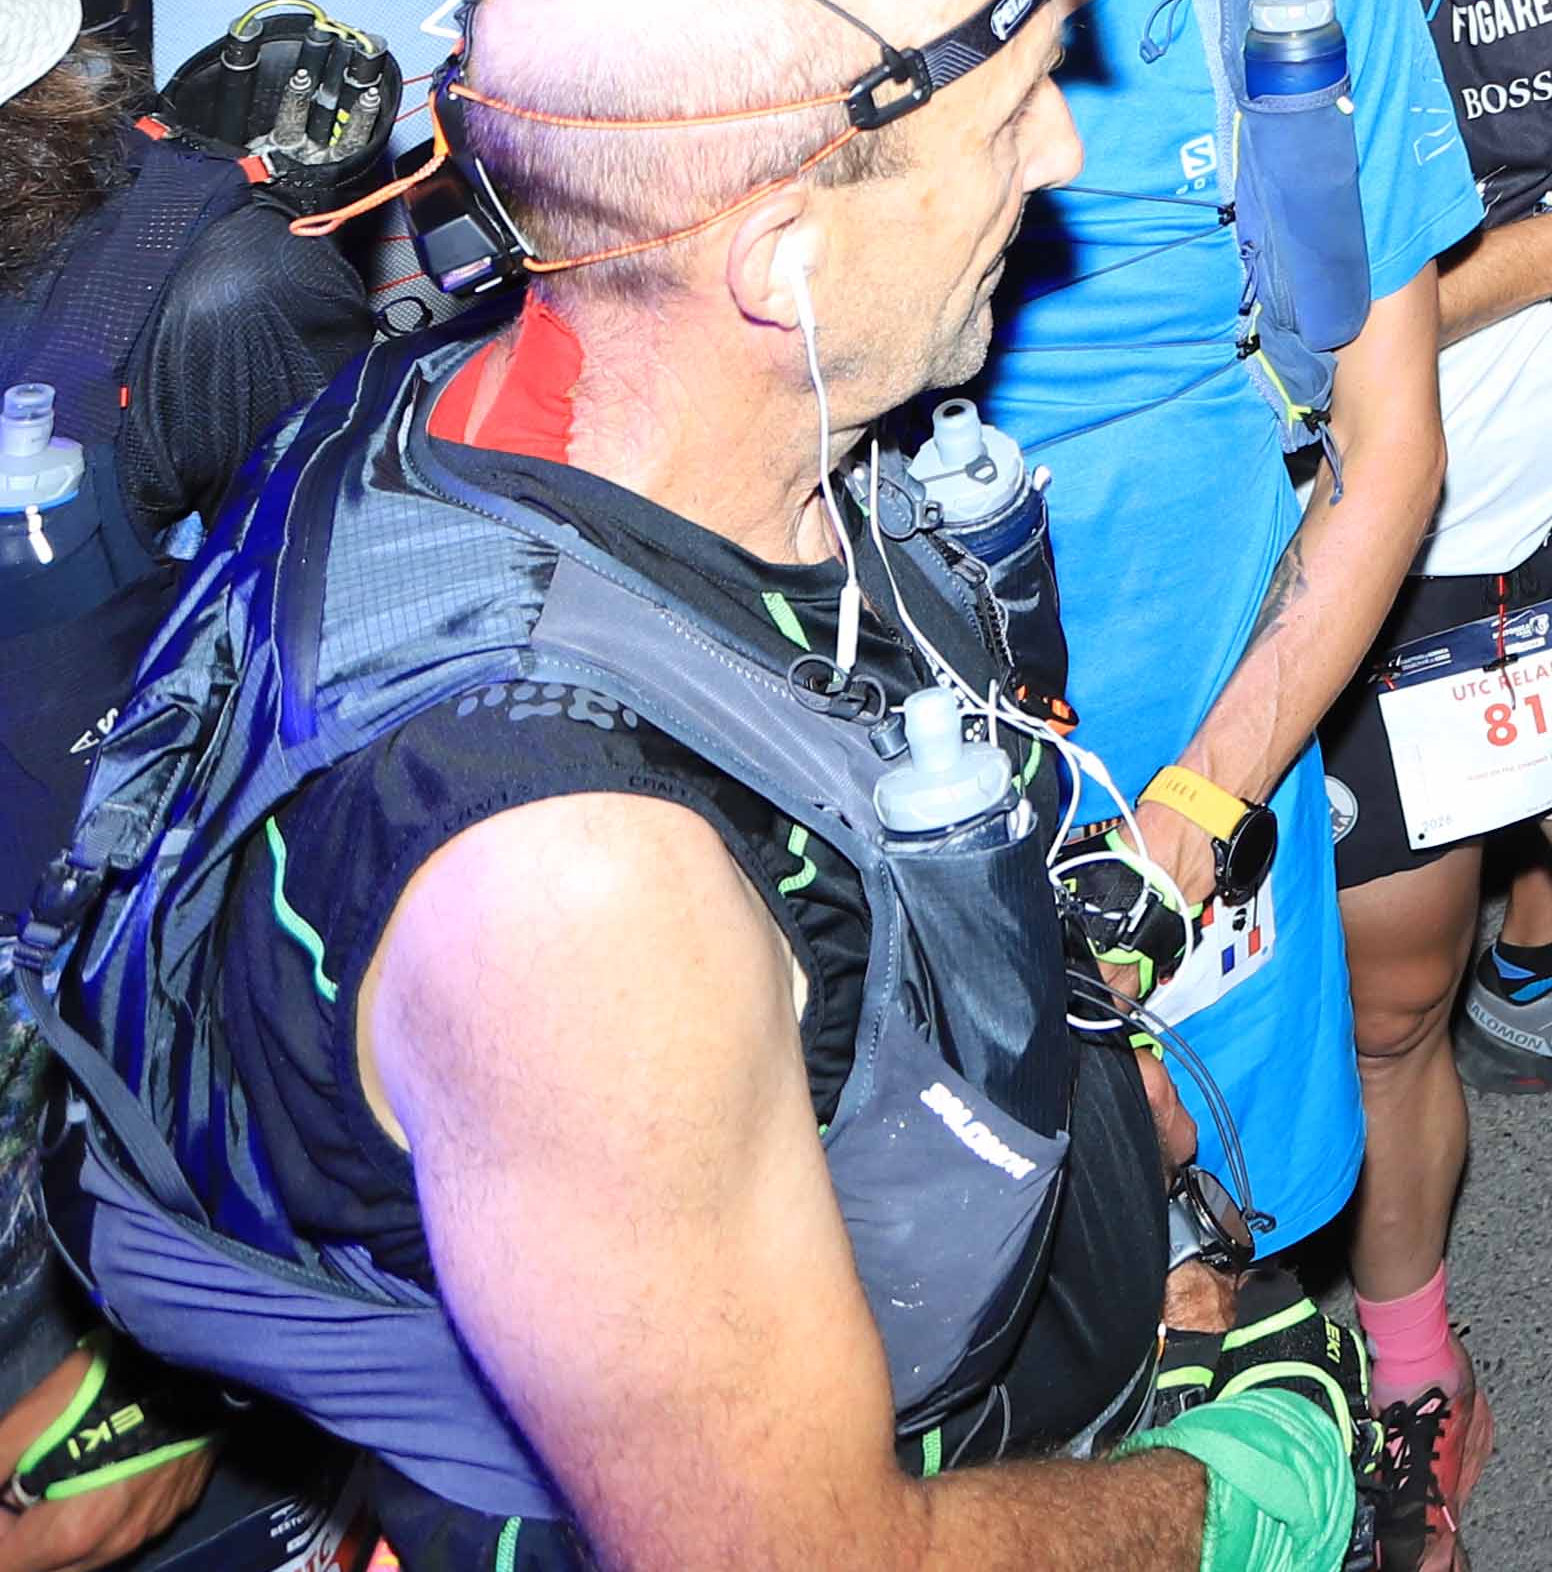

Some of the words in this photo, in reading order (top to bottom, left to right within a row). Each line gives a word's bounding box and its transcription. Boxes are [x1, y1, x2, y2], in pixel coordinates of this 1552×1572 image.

[1451, 680, 1488, 703] UTC
[1469, 999, 1545, 1052] ALOMON
[920, 1081, 1037, 1180] SALOMON
[66, 1403, 144, 1461] EKI
